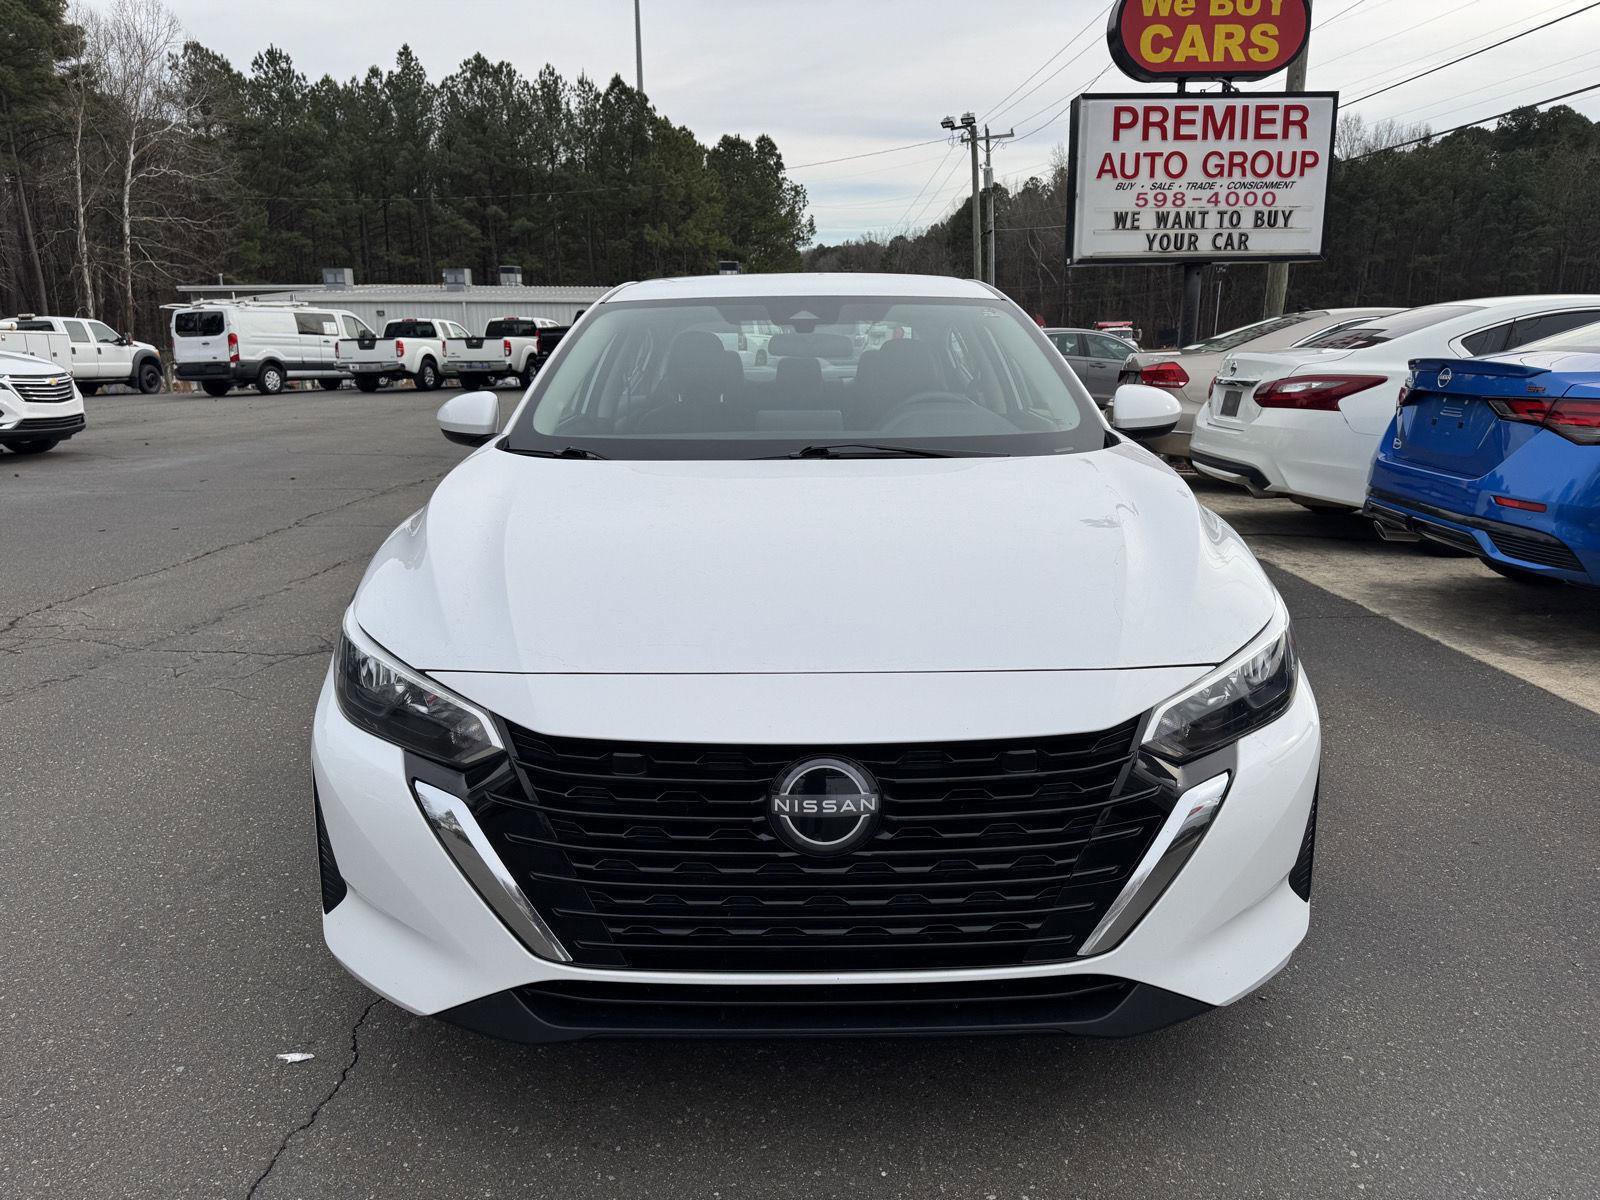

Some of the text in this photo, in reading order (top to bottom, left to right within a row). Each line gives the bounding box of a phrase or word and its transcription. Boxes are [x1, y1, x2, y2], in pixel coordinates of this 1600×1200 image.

[1139, 23, 1280, 63] CARS
[1112, 104, 1309, 142] PREMIER
[1096, 150, 1320, 180] AUTO GROUP
[1115, 181, 1296, 191] BUY SALE TRADE CONSIGNMENT
[1135, 191, 1277, 208] 598-4000
[1113, 210, 1294, 230] WE WANT TO BUY
[1146, 232, 1250, 251] YOUR CAR
[774, 798, 876, 813] NISSAN
